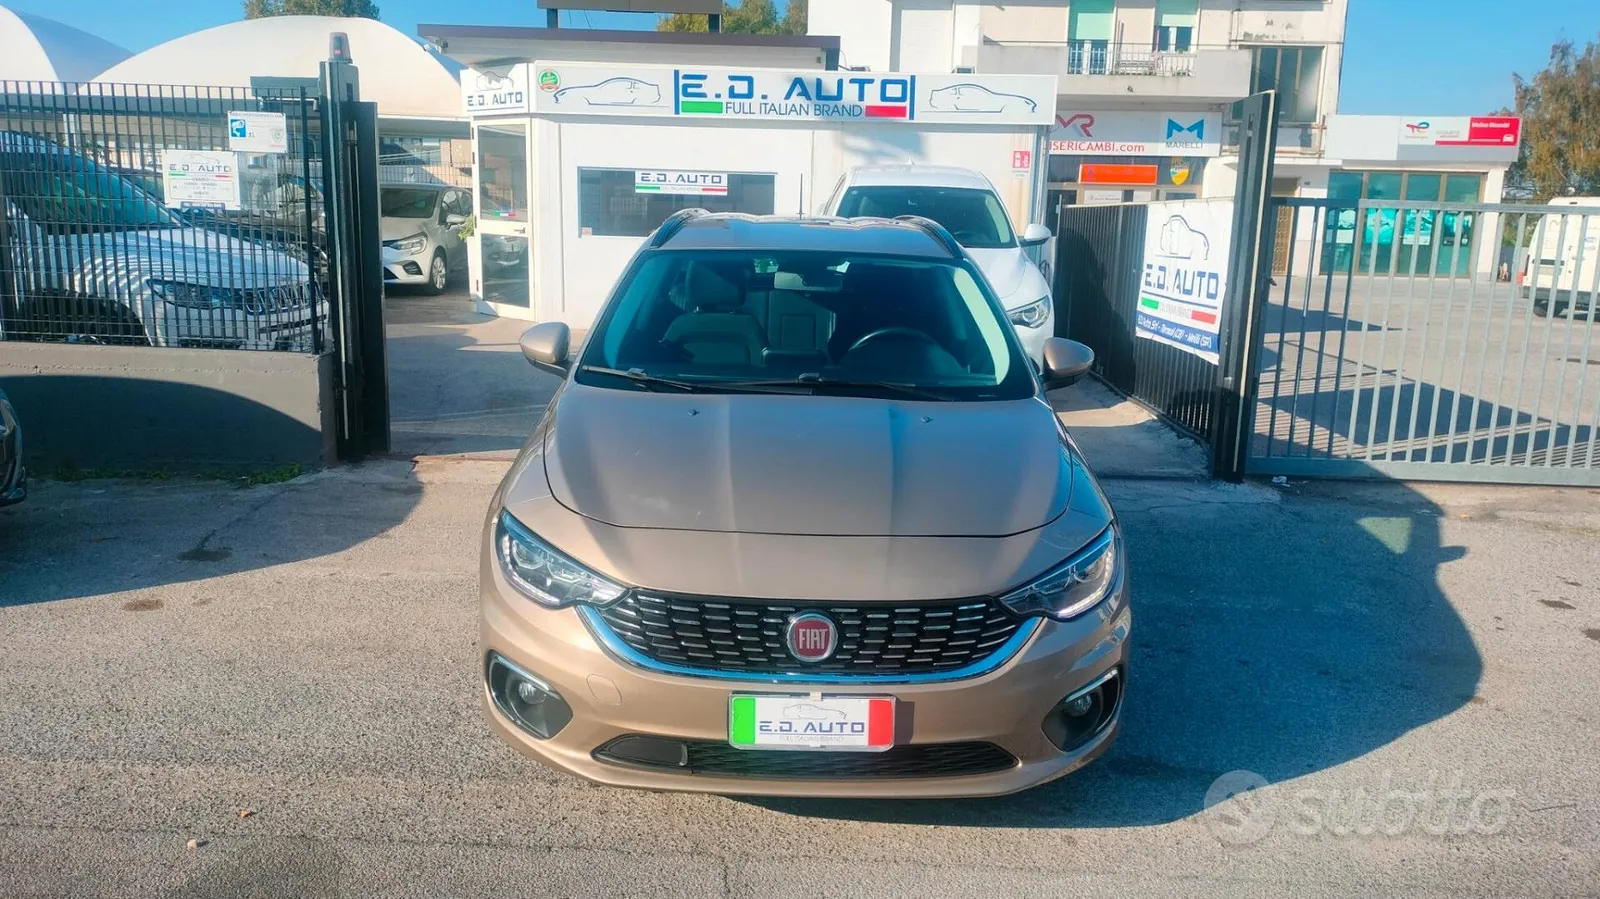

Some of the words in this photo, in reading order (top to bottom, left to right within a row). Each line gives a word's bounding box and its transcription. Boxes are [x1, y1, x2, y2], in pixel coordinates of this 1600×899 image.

[681, 73, 768, 100] E.D.
[784, 76, 908, 102] AUTO
[467, 94, 488, 107] E.D.
[491, 91, 523, 105] AUTO
[725, 101, 755, 115] FULL
[759, 102, 809, 117] ITALIAN
[814, 104, 863, 118] BRAND
[1165, 141, 1204, 149] MARELLI
[169, 163, 193, 171] E.D.
[640, 172, 672, 183] E.D.
[675, 173, 722, 184] AUTO
[1144, 263, 1169, 291] E.D.
[1172, 268, 1220, 301] AUTO
[798, 628, 828, 650] FIAT
[759, 720, 797, 733] E.D.
[803, 721, 865, 734] AUTO
